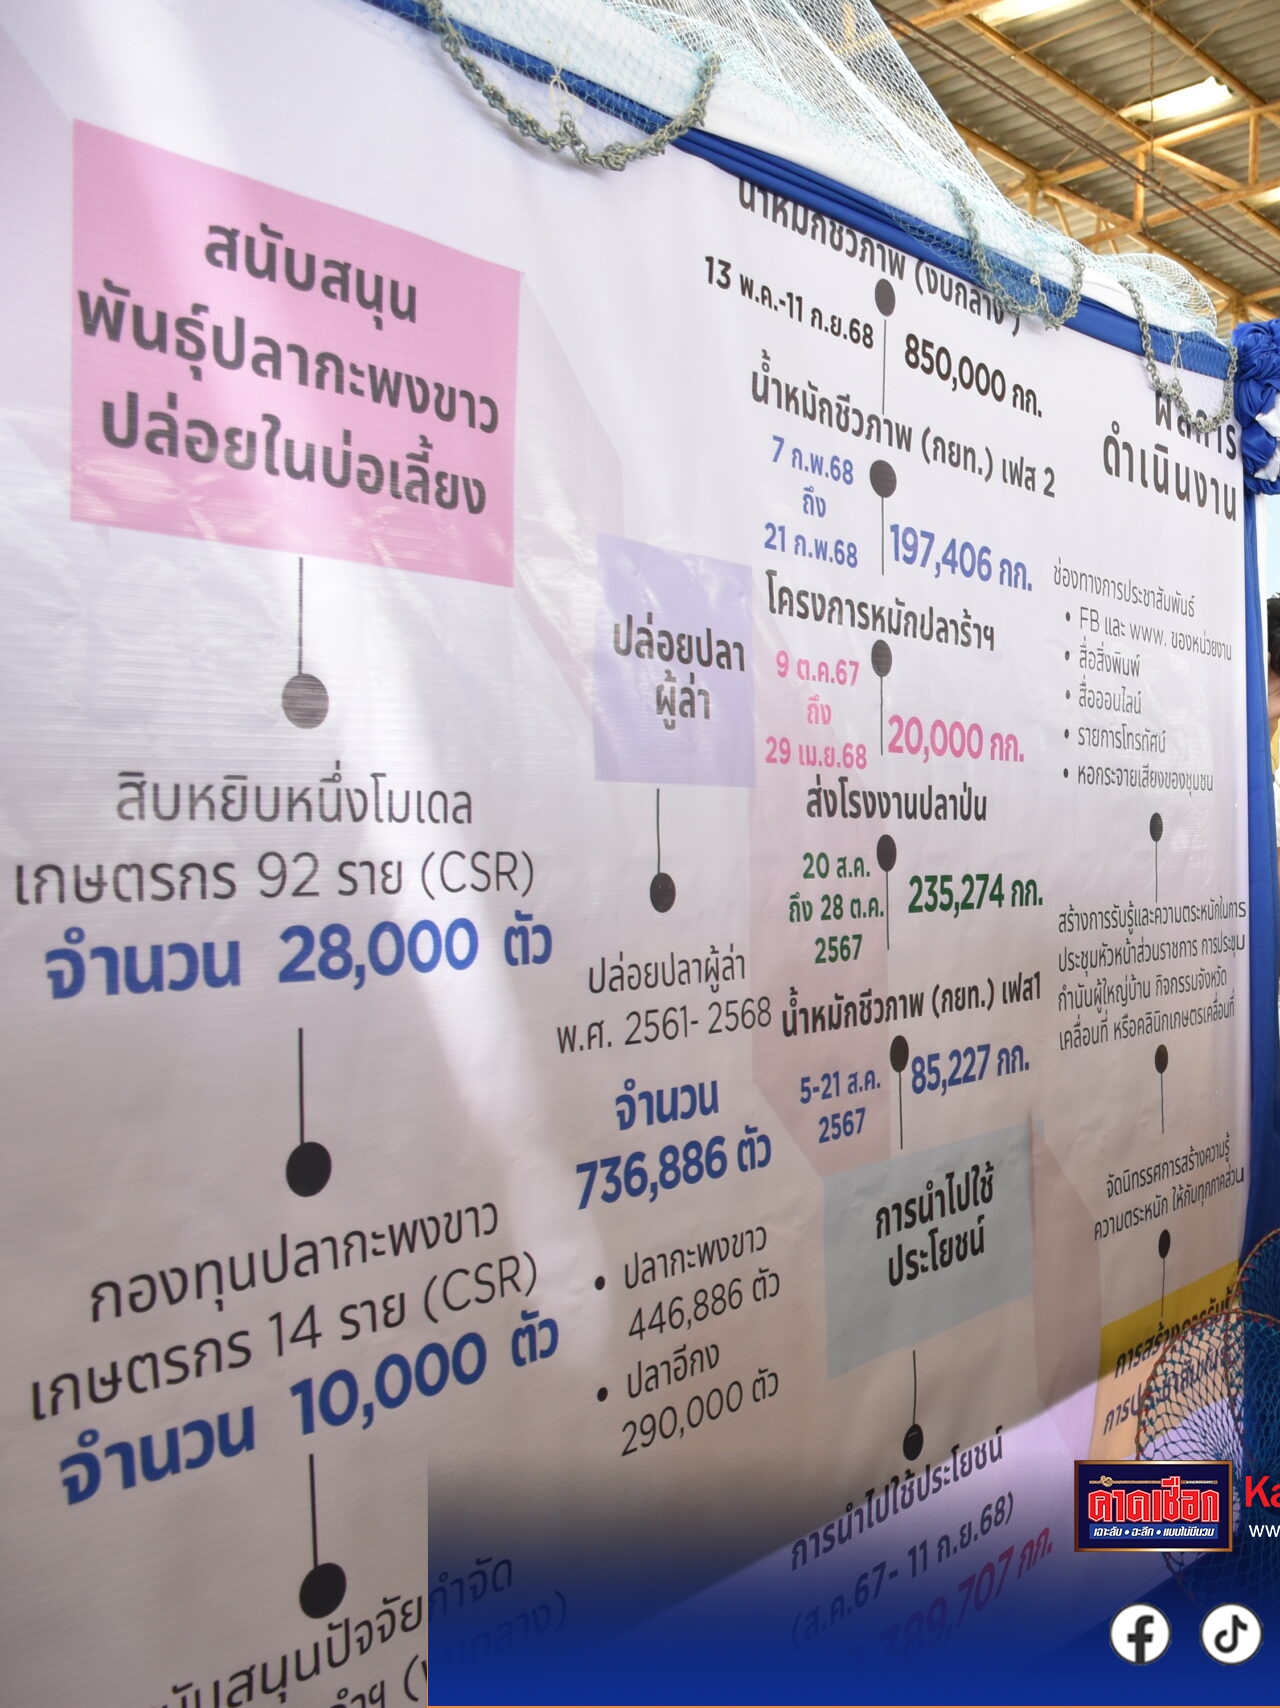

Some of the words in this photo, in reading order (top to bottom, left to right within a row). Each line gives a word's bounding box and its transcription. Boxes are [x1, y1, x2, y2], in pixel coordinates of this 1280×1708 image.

[205, 223, 417, 330] สนับสนุน
[705, 255, 731, 289] 13
[739, 273, 803, 323] พ.ค.-11
[811, 307, 874, 349] ก.ย.68
[78, 278, 499, 434] พันธุ์ปลากะพงขาว
[905, 334, 1006, 402] 850,000
[1012, 382, 1043, 418] กก.
[102, 391, 487, 515] ปล่อยในบ่อเลี้ยง
[751, 349, 912, 452] น้ำหมักชีวภาพ
[921, 426, 993, 481] (กยท.)
[1002, 452, 1037, 492] เฟส
[1043, 468, 1056, 498] 2
[772, 436, 785, 463] 7
[791, 448, 854, 486] ก.พ.68
[1103, 421, 1237, 522] ดำเนินงาน
[802, 486, 827, 518] ถึง
[764, 522, 787, 552] 21
[793, 532, 858, 569] ก.พ.68
[890, 524, 992, 582] 197,406
[1000, 556, 1033, 592] กก.
[765, 569, 995, 651] โครงการหมักปลาร้าฯ
[1054, 557, 1195, 618] ช่องทางการประชาสัมพันธ์
[613, 612, 745, 672] ปล่อยปลา
[1080, 606, 1099, 632] FB
[1105, 615, 1126, 637] และ
[1171, 630, 1232, 661] ของหน่วยงาน
[775, 650, 789, 678] 9
[796, 656, 860, 687] ต.ค.67
[1079, 674, 1142, 715] สื่อออนไลน์
[656, 669, 710, 730] ผู้ล่า
[807, 695, 832, 726] ถึง
[765, 735, 791, 765] 29
[798, 741, 867, 770] เม.ย.68
[888, 714, 984, 763] 20,000
[990, 730, 1024, 763] กก.
[1078, 723, 1166, 753] รายการโทรทัศน์
[116, 760, 473, 824] สิบหยิบหนึ่งโมเดล
[806, 774, 987, 822] ส่งโรงงานปลาป่น
[1077, 763, 1213, 797] หอกระจายเสียงของชุมชน
[15, 861, 236, 906] เกษตรกร
[257, 850, 321, 898] 92
[338, 859, 403, 897] ราย
[420, 850, 535, 901] (CSR)
[802, 852, 830, 880] 20
[836, 853, 870, 879] ส.ค.
[908, 872, 1005, 917] 235,274
[1011, 877, 1043, 908] กก.
[788, 894, 813, 924] ถึง
[820, 893, 843, 920] 28
[850, 894, 884, 920] ต.ค.
[45, 926, 241, 1000] จำนวน
[278, 917, 480, 990] 28,000
[504, 910, 553, 967] ตัว
[588, 943, 746, 994] ปล่อยปลาผู้ล่า
[815, 934, 863, 965] 2567
[1058, 936, 1198, 977] ประชุมหัวหน้าส่วนราชการ
[1201, 931, 1246, 958] การประชุม
[782, 986, 924, 1037] น้ำหมักชีวภาพ
[932, 976, 994, 1019] (กยท.)
[1058, 973, 1151, 1014] กำนันผู้ใหญ่บ้าน
[1155, 965, 1227, 996] กิจกรรมจังหวัด
[1059, 1009, 1109, 1051] เคลื่อนที่
[1113, 987, 1235, 1040] หรือคลินิกเกษตรเคลื่อนที่
[557, 1020, 612, 1053] พ.ศ.
[625, 1005, 698, 1045] 2561-
[708, 996, 772, 1034] 2568
[800, 1070, 841, 1104] 5-21
[847, 1069, 881, 1099] ส.ค.
[910, 1043, 991, 1097] 85,227
[996, 1043, 1030, 1077] กก.
[615, 1078, 719, 1131] จำนวน
[818, 1107, 866, 1143] 2567
[576, 1135, 728, 1211] 736,886
[737, 1125, 772, 1173] ตัว
[1106, 1132, 1231, 1198] จัดนิทรรศการสร้างความรู้
[875, 1165, 994, 1239] การนำไปใช้
[1094, 1194, 1169, 1241] ความตระหนัก
[1172, 1164, 1244, 1211] ให้กับทุกภาคส่วน
[90, 1202, 499, 1323] กองทุนปลากะพงขาว
[624, 1225, 768, 1291] ปลากะพงขาว
[888, 1214, 986, 1286] ประโยชน์
[31, 1329, 252, 1421] เกษตรกร
[268, 1305, 323, 1357] 14
[340, 1292, 406, 1340] ราย
[423, 1251, 538, 1324] (CSR)
[628, 1278, 743, 1343] 446,886
[752, 1268, 780, 1302] ตัว
[626, 1341, 720, 1401] ปลาอีกง
[59, 1405, 256, 1506] จำนวน
[289, 1331, 488, 1436] 10,000
[511, 1309, 560, 1368] ตัว
[621, 1380, 743, 1457] 290,000
[752, 1370, 780, 1402] ตัว
[791, 1425, 1003, 1570] การนำไปใช้ประโยชน์
[907, 1540, 928, 1578] 11
[936, 1492, 1015, 1560] ก.ย.68)
